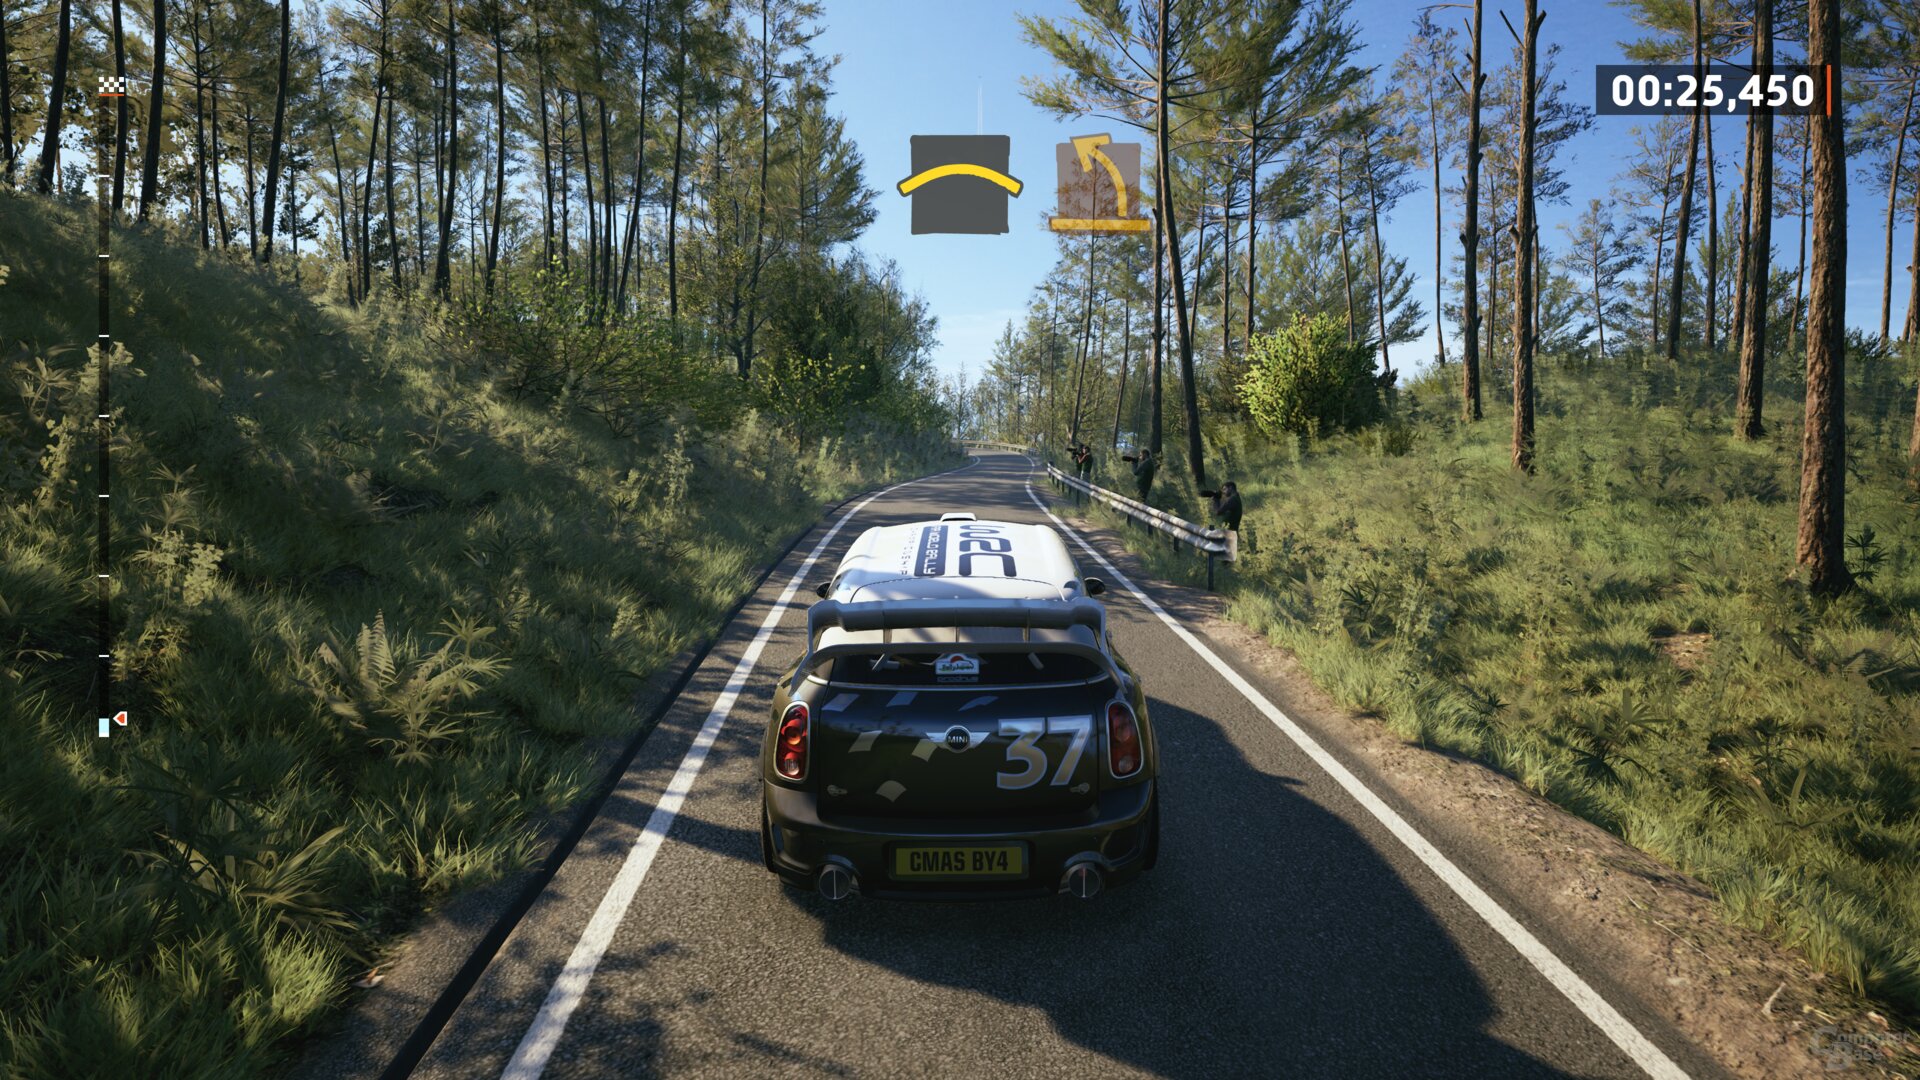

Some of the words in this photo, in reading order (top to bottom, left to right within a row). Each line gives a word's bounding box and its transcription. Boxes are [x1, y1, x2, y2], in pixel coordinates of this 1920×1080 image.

[923, 549, 938, 575] RALLY
[959, 525, 1017, 577] WRC
[947, 735, 968, 744] MINI
[996, 714, 1093, 790] 37
[909, 851, 965, 872] CMAS
[972, 851, 1009, 872] BY4
